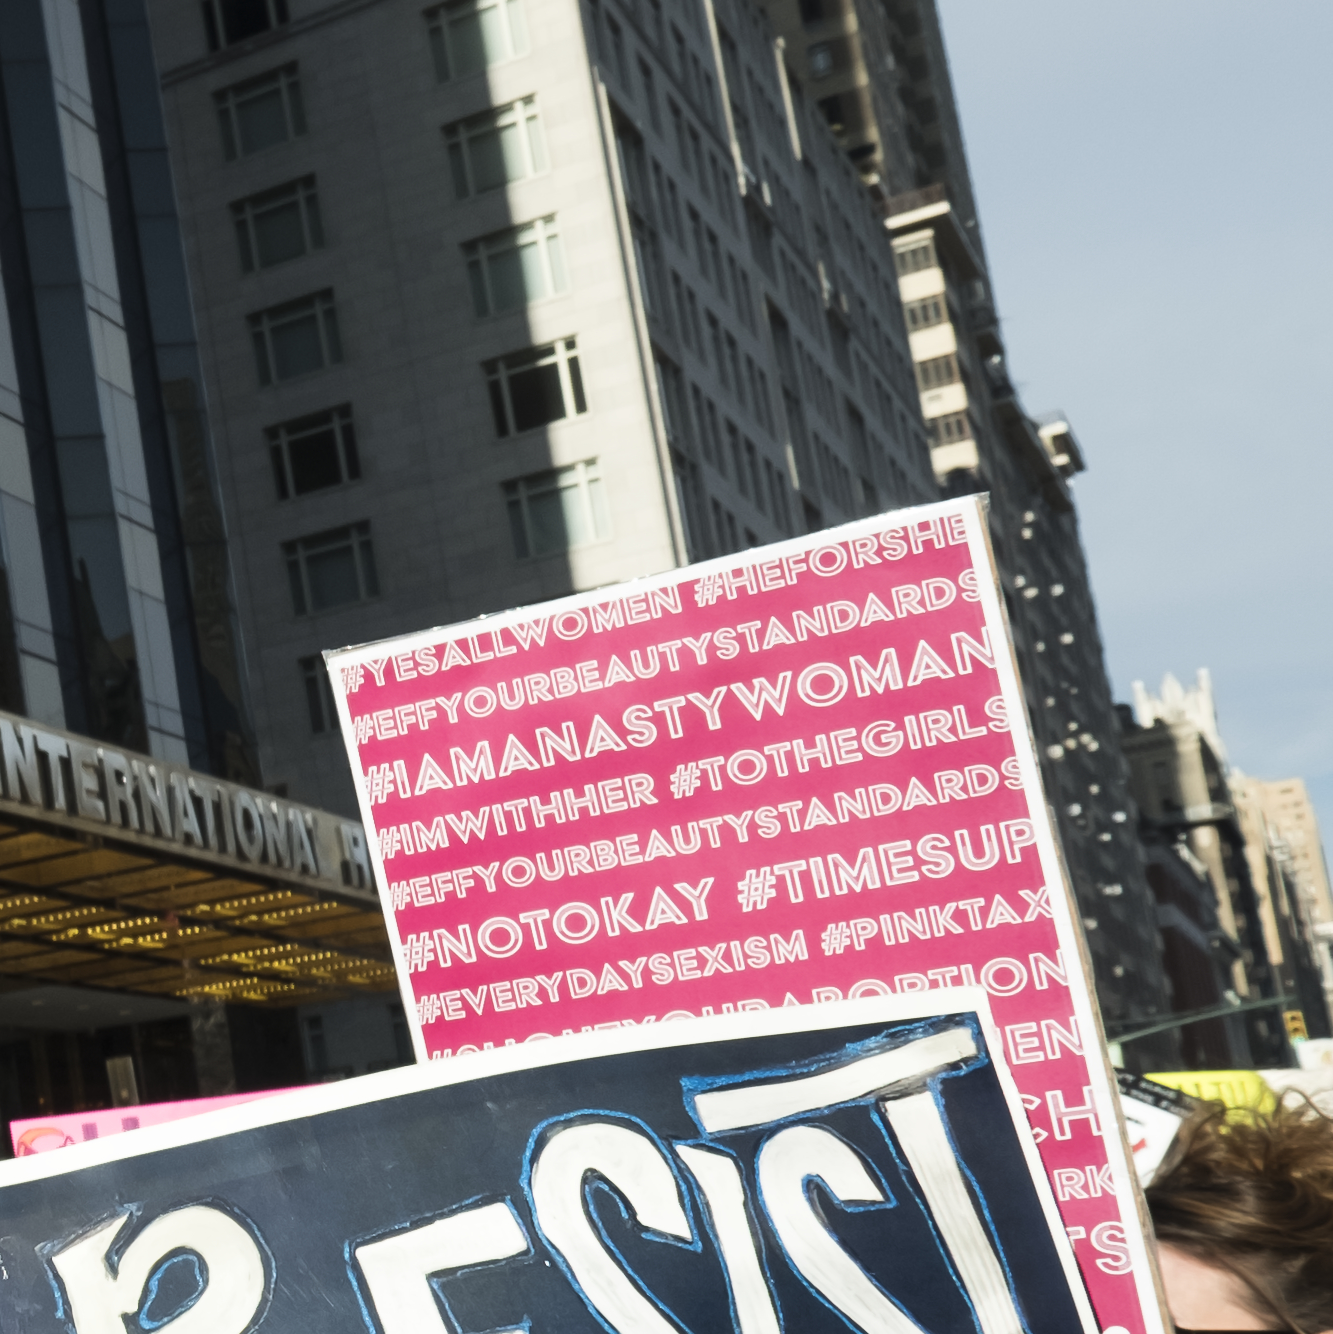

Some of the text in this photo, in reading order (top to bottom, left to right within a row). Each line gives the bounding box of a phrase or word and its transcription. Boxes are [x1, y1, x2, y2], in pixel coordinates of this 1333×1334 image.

[340, 513, 968, 694] #YESALLWOMEN #HEFORSHE
[351, 568, 982, 745] #EFFYOURBEAUTYSTANDARDS
[363, 626, 997, 806] #IAMANASTYWOMAN
[376, 694, 1011, 860] #IMWITHHER #TOTHEGIRLS
[389, 756, 1026, 911] #EFFYOURBEAUTYSTANDARDS
[402, 818, 1037, 973] #NOTOKAY #TIMESUP
[415, 931, 808, 1025] #EVERYDAYSEXISM
[820, 886, 1054, 956] #PINKTAX
